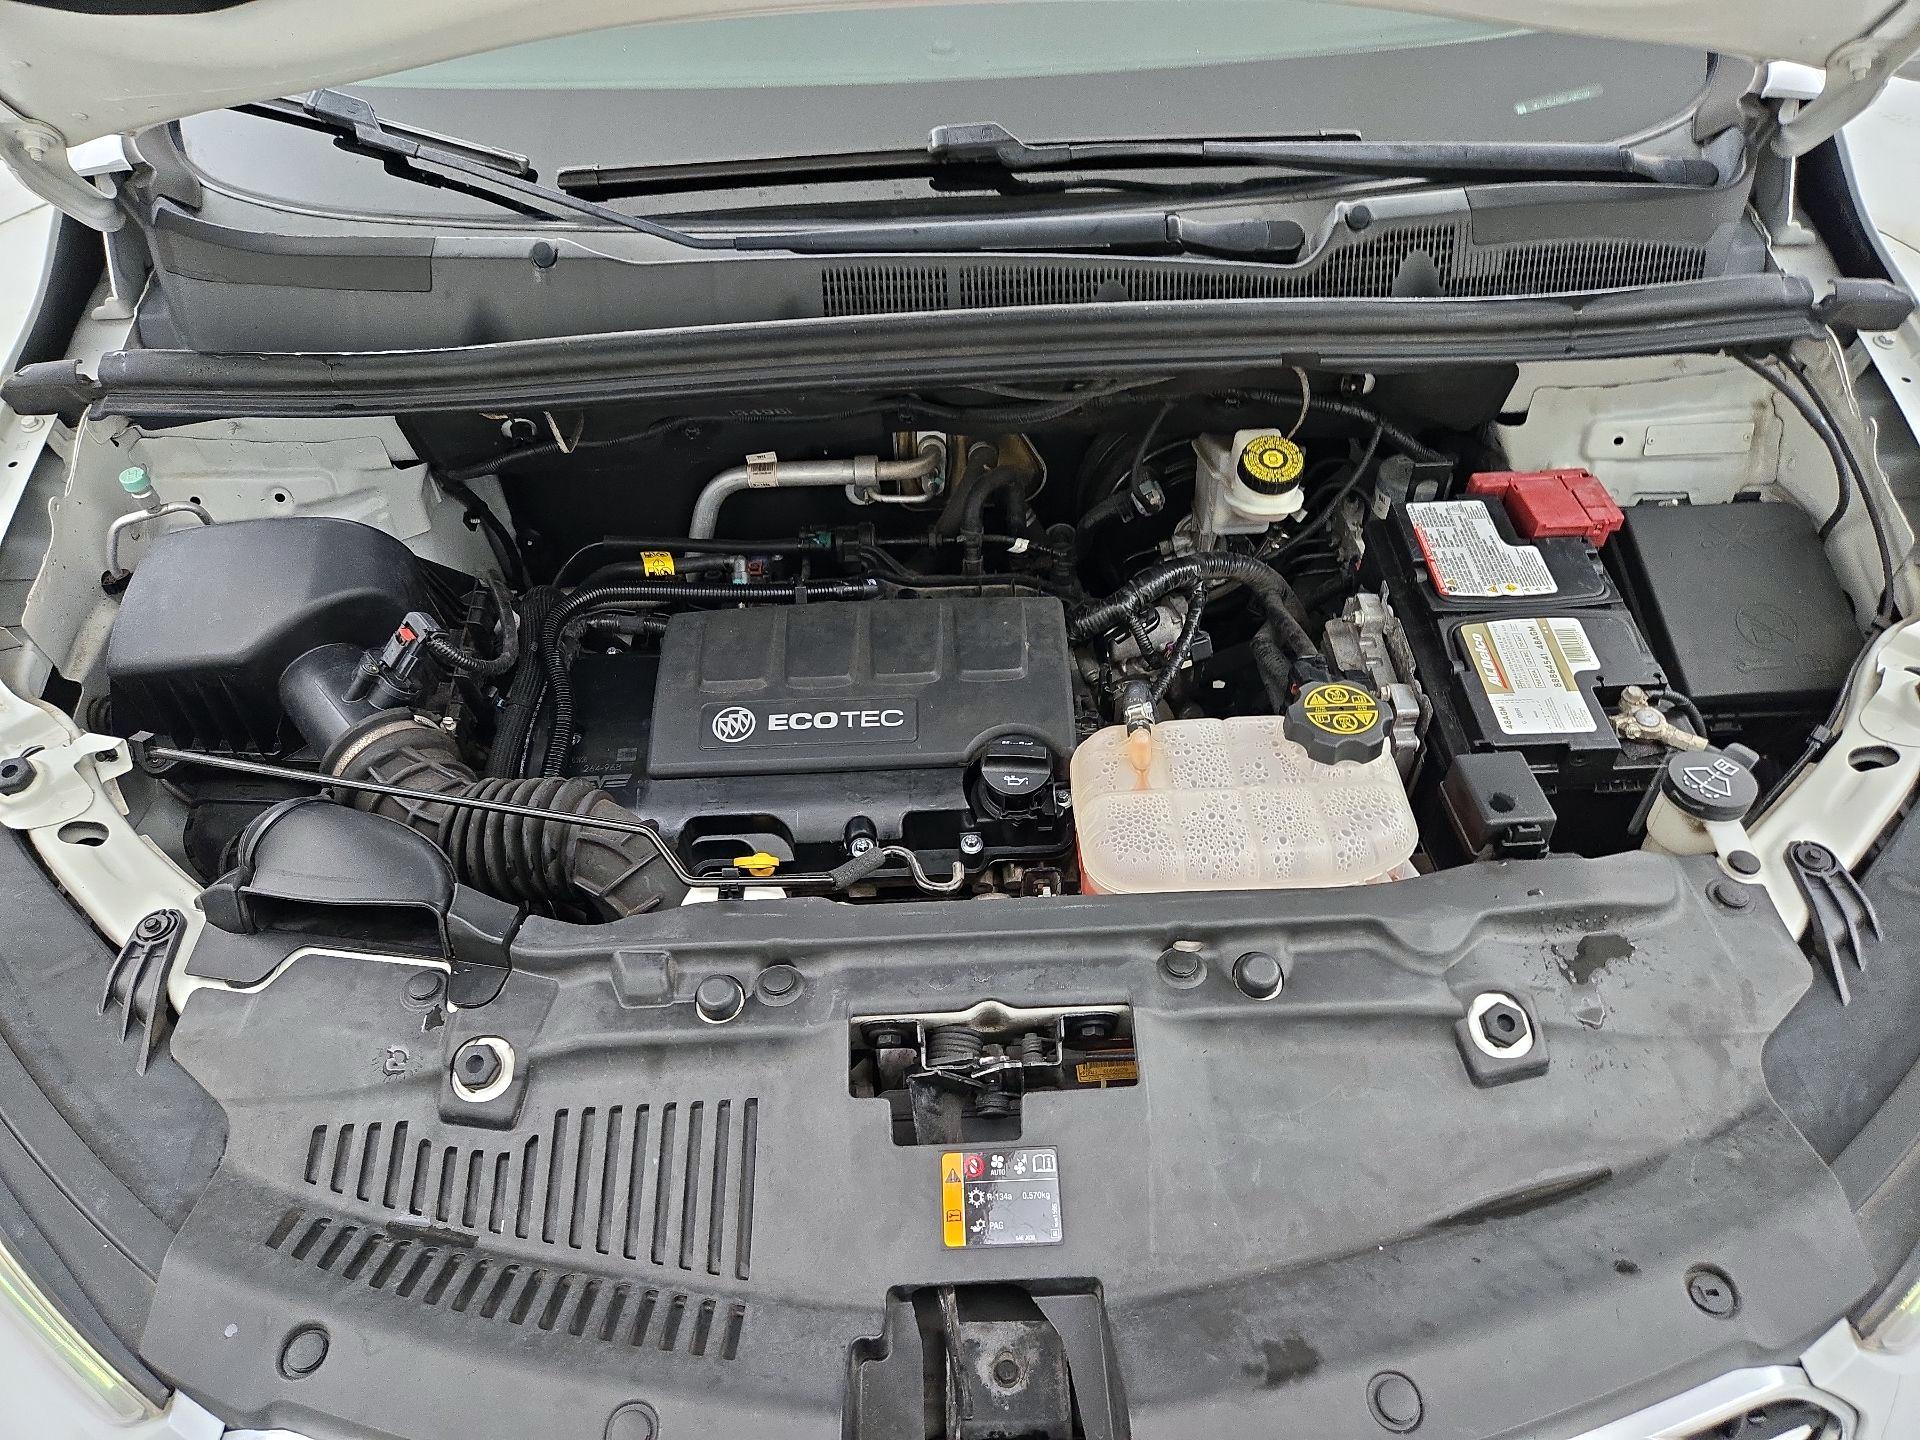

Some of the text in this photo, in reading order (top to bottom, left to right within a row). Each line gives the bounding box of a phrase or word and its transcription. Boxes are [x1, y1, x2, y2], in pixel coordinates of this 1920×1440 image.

[1528, 626, 1544, 650] 48AGM
[1472, 633, 1502, 687] ACDelco
[1539, 653, 1562, 688] 88864541
[767, 709, 905, 731] ECOTEC
[1499, 706, 1513, 729] 48AGM
[1022, 1191, 1051, 1201] 0.570kg
[989, 1221, 1004, 1230] PAG
